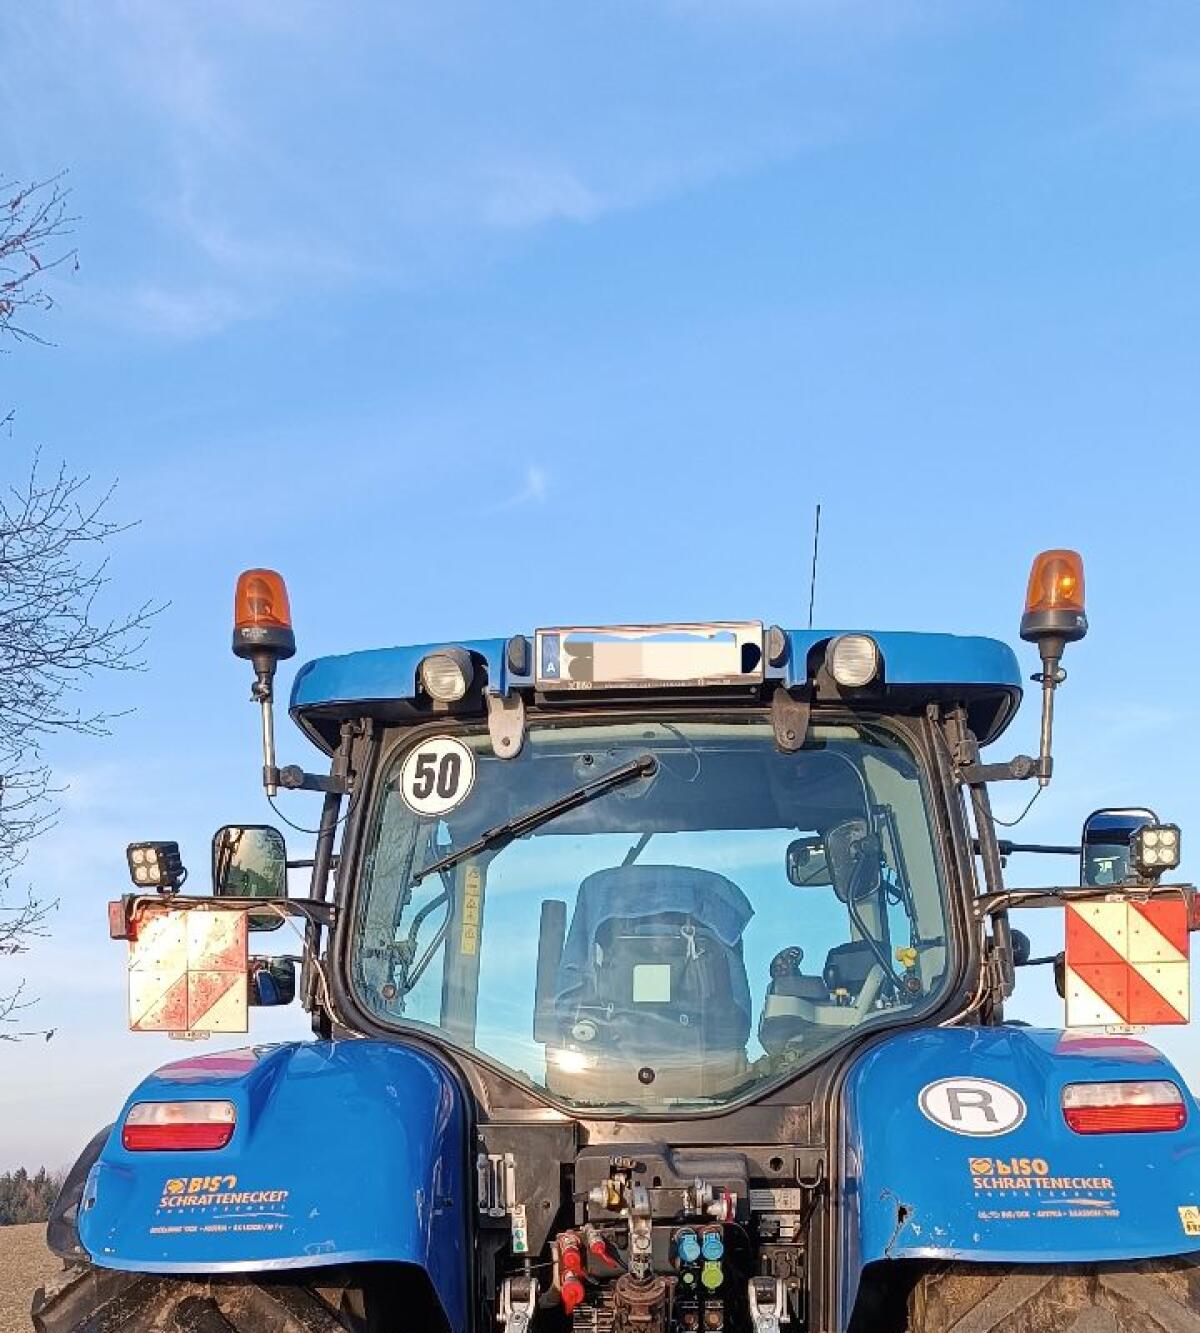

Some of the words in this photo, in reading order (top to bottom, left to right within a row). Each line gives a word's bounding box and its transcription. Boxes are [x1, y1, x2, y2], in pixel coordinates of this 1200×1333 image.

[546, 662, 556, 673] A
[413, 753, 461, 798] 50
[947, 1088, 998, 1122] R
[974, 1177, 1114, 1189] SCHRATTENECKER
